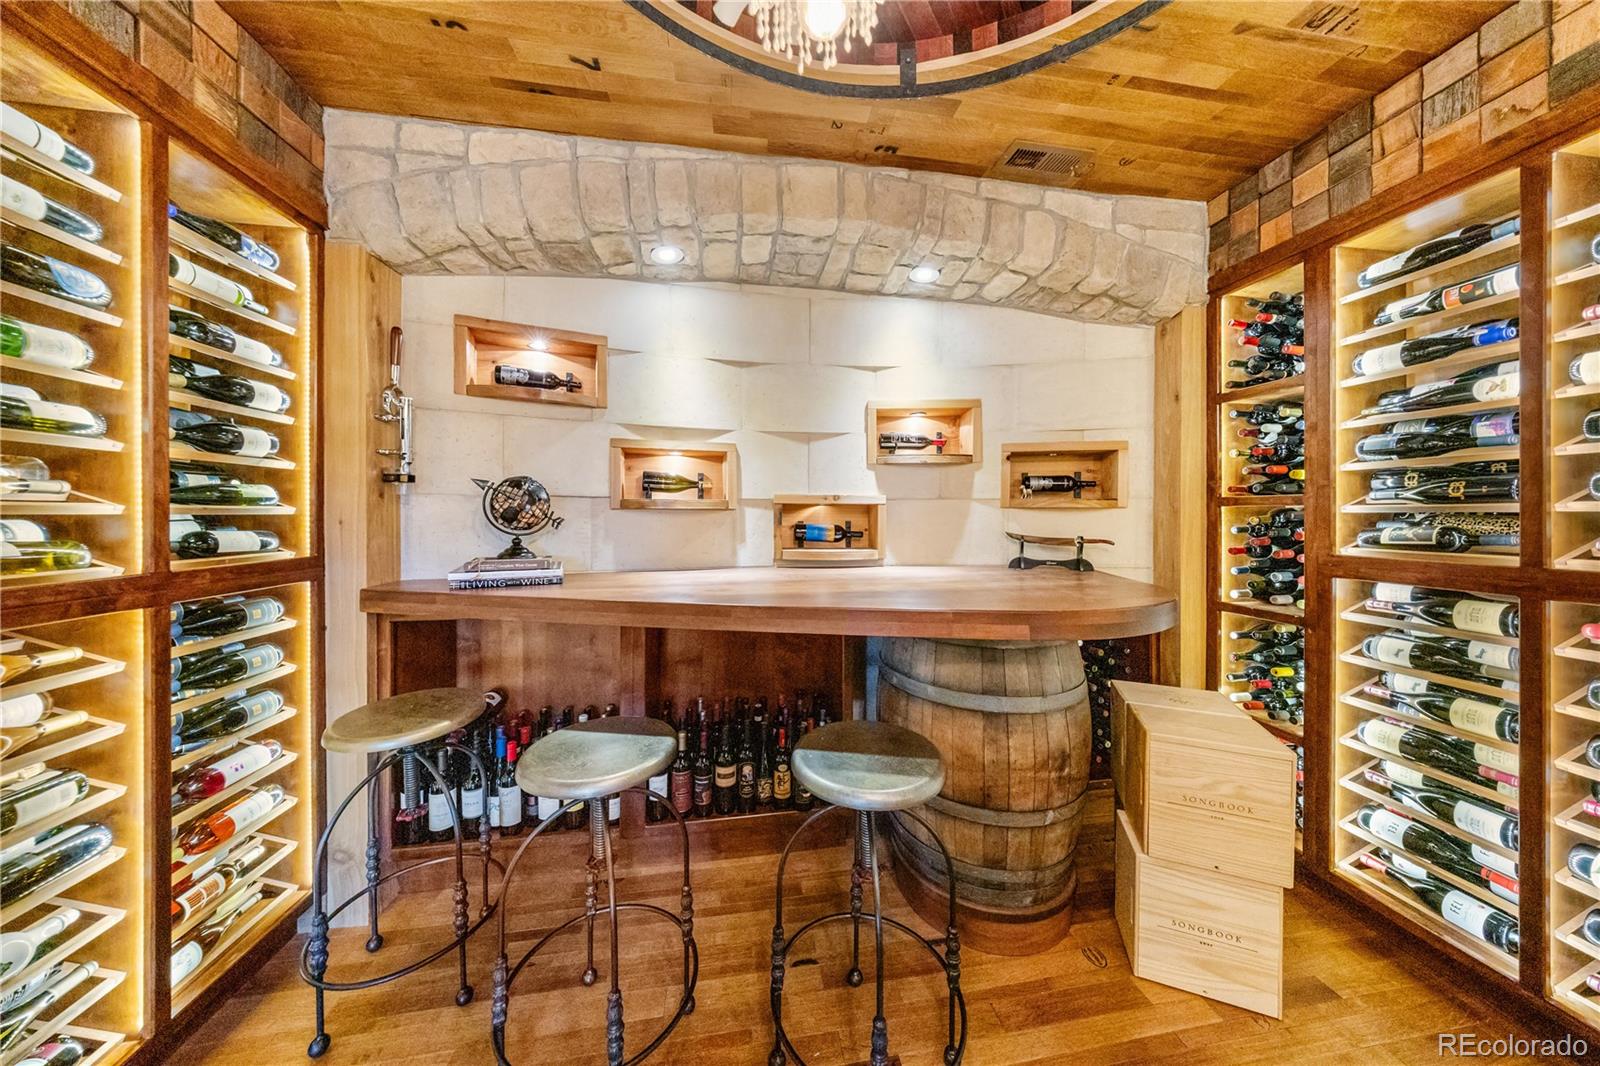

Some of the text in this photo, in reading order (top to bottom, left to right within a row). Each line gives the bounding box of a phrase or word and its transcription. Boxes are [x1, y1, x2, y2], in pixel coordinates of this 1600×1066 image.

[466, 579, 506, 589] LIVING
[520, 577, 550, 586] WINE
[1182, 795, 1255, 815] SONGBOOK
[1171, 919, 1244, 944] SONGBOOK
